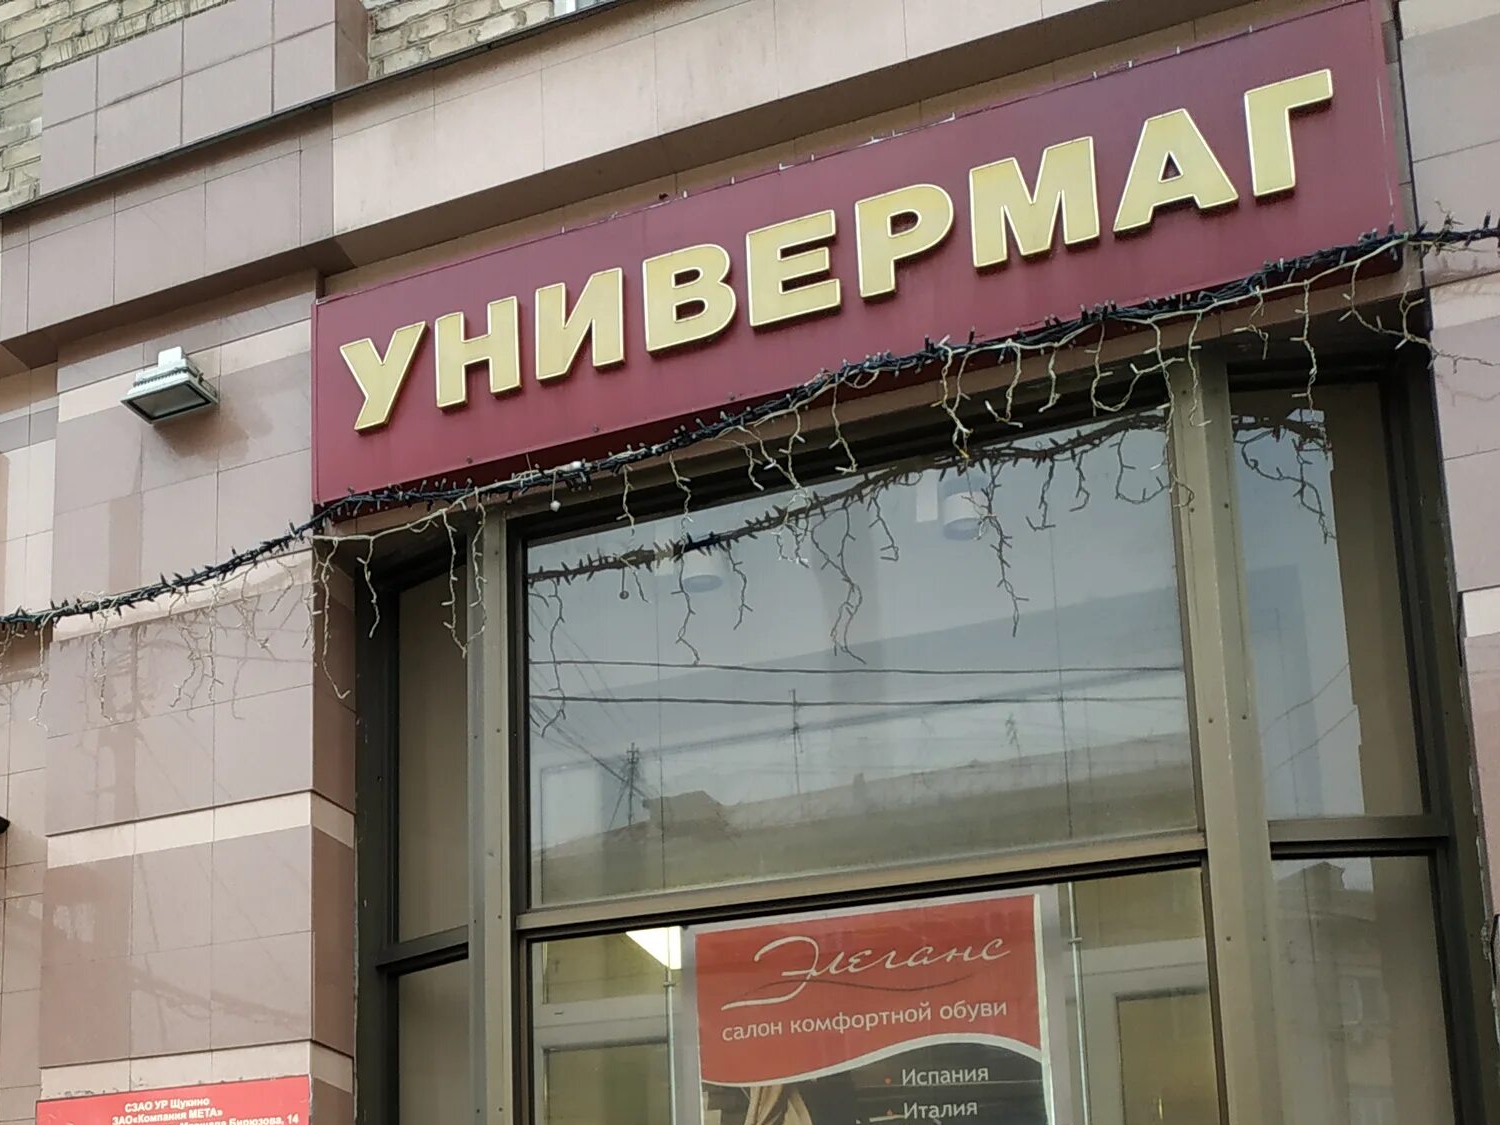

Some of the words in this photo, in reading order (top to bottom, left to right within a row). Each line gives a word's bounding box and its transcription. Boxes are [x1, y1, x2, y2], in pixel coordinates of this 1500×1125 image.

[338, 68, 1334, 433] УНИВЕРМАГ
[721, 936, 1011, 1011] Элеганс
[722, 1021, 783, 1042] салон
[791, 1003, 932, 1034] комфортной
[940, 1001, 1007, 1021] обуви
[902, 1068, 989, 1086] Испания
[124, 1101, 153, 1113] СЗАО
[170, 1098, 210, 1109] Щукино
[903, 1102, 978, 1119] Италия
[287, 1113, 299, 1124] 14
